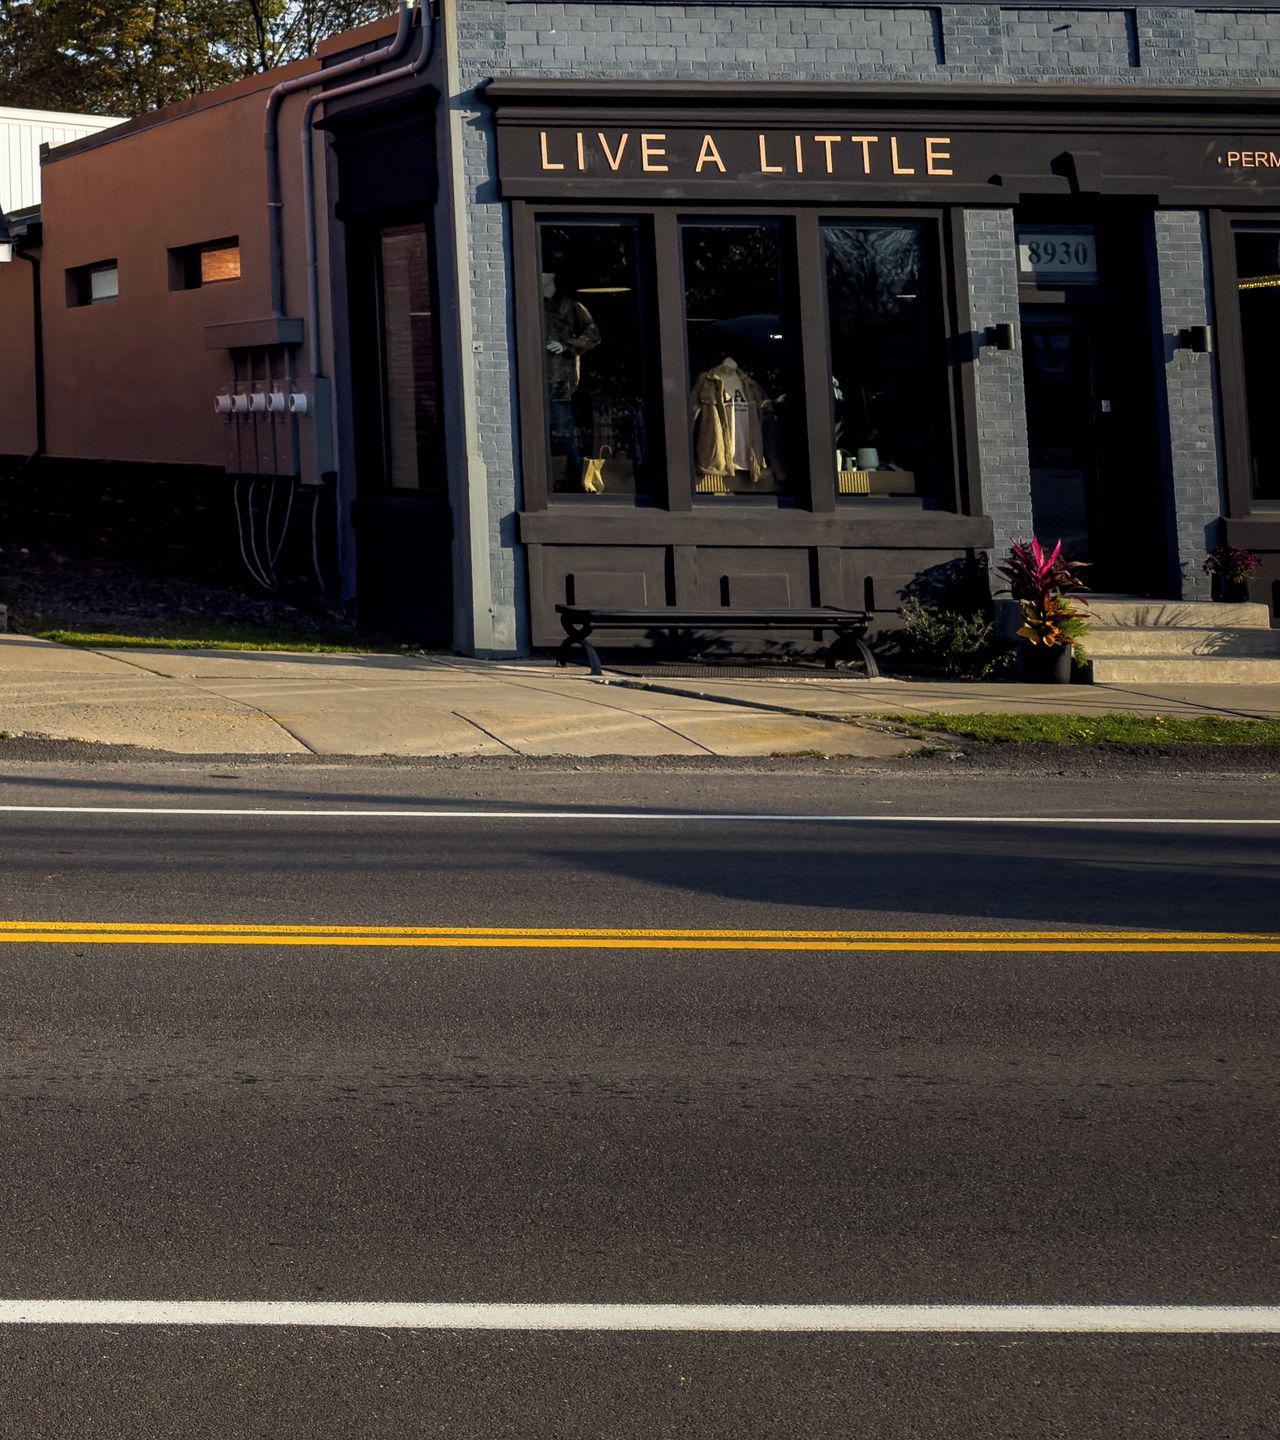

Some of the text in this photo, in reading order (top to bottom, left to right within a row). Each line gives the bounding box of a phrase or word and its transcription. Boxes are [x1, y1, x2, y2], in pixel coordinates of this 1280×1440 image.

[540, 132, 954, 176] LIVE A LITTLE
[1028, 241, 1088, 266] 8930
